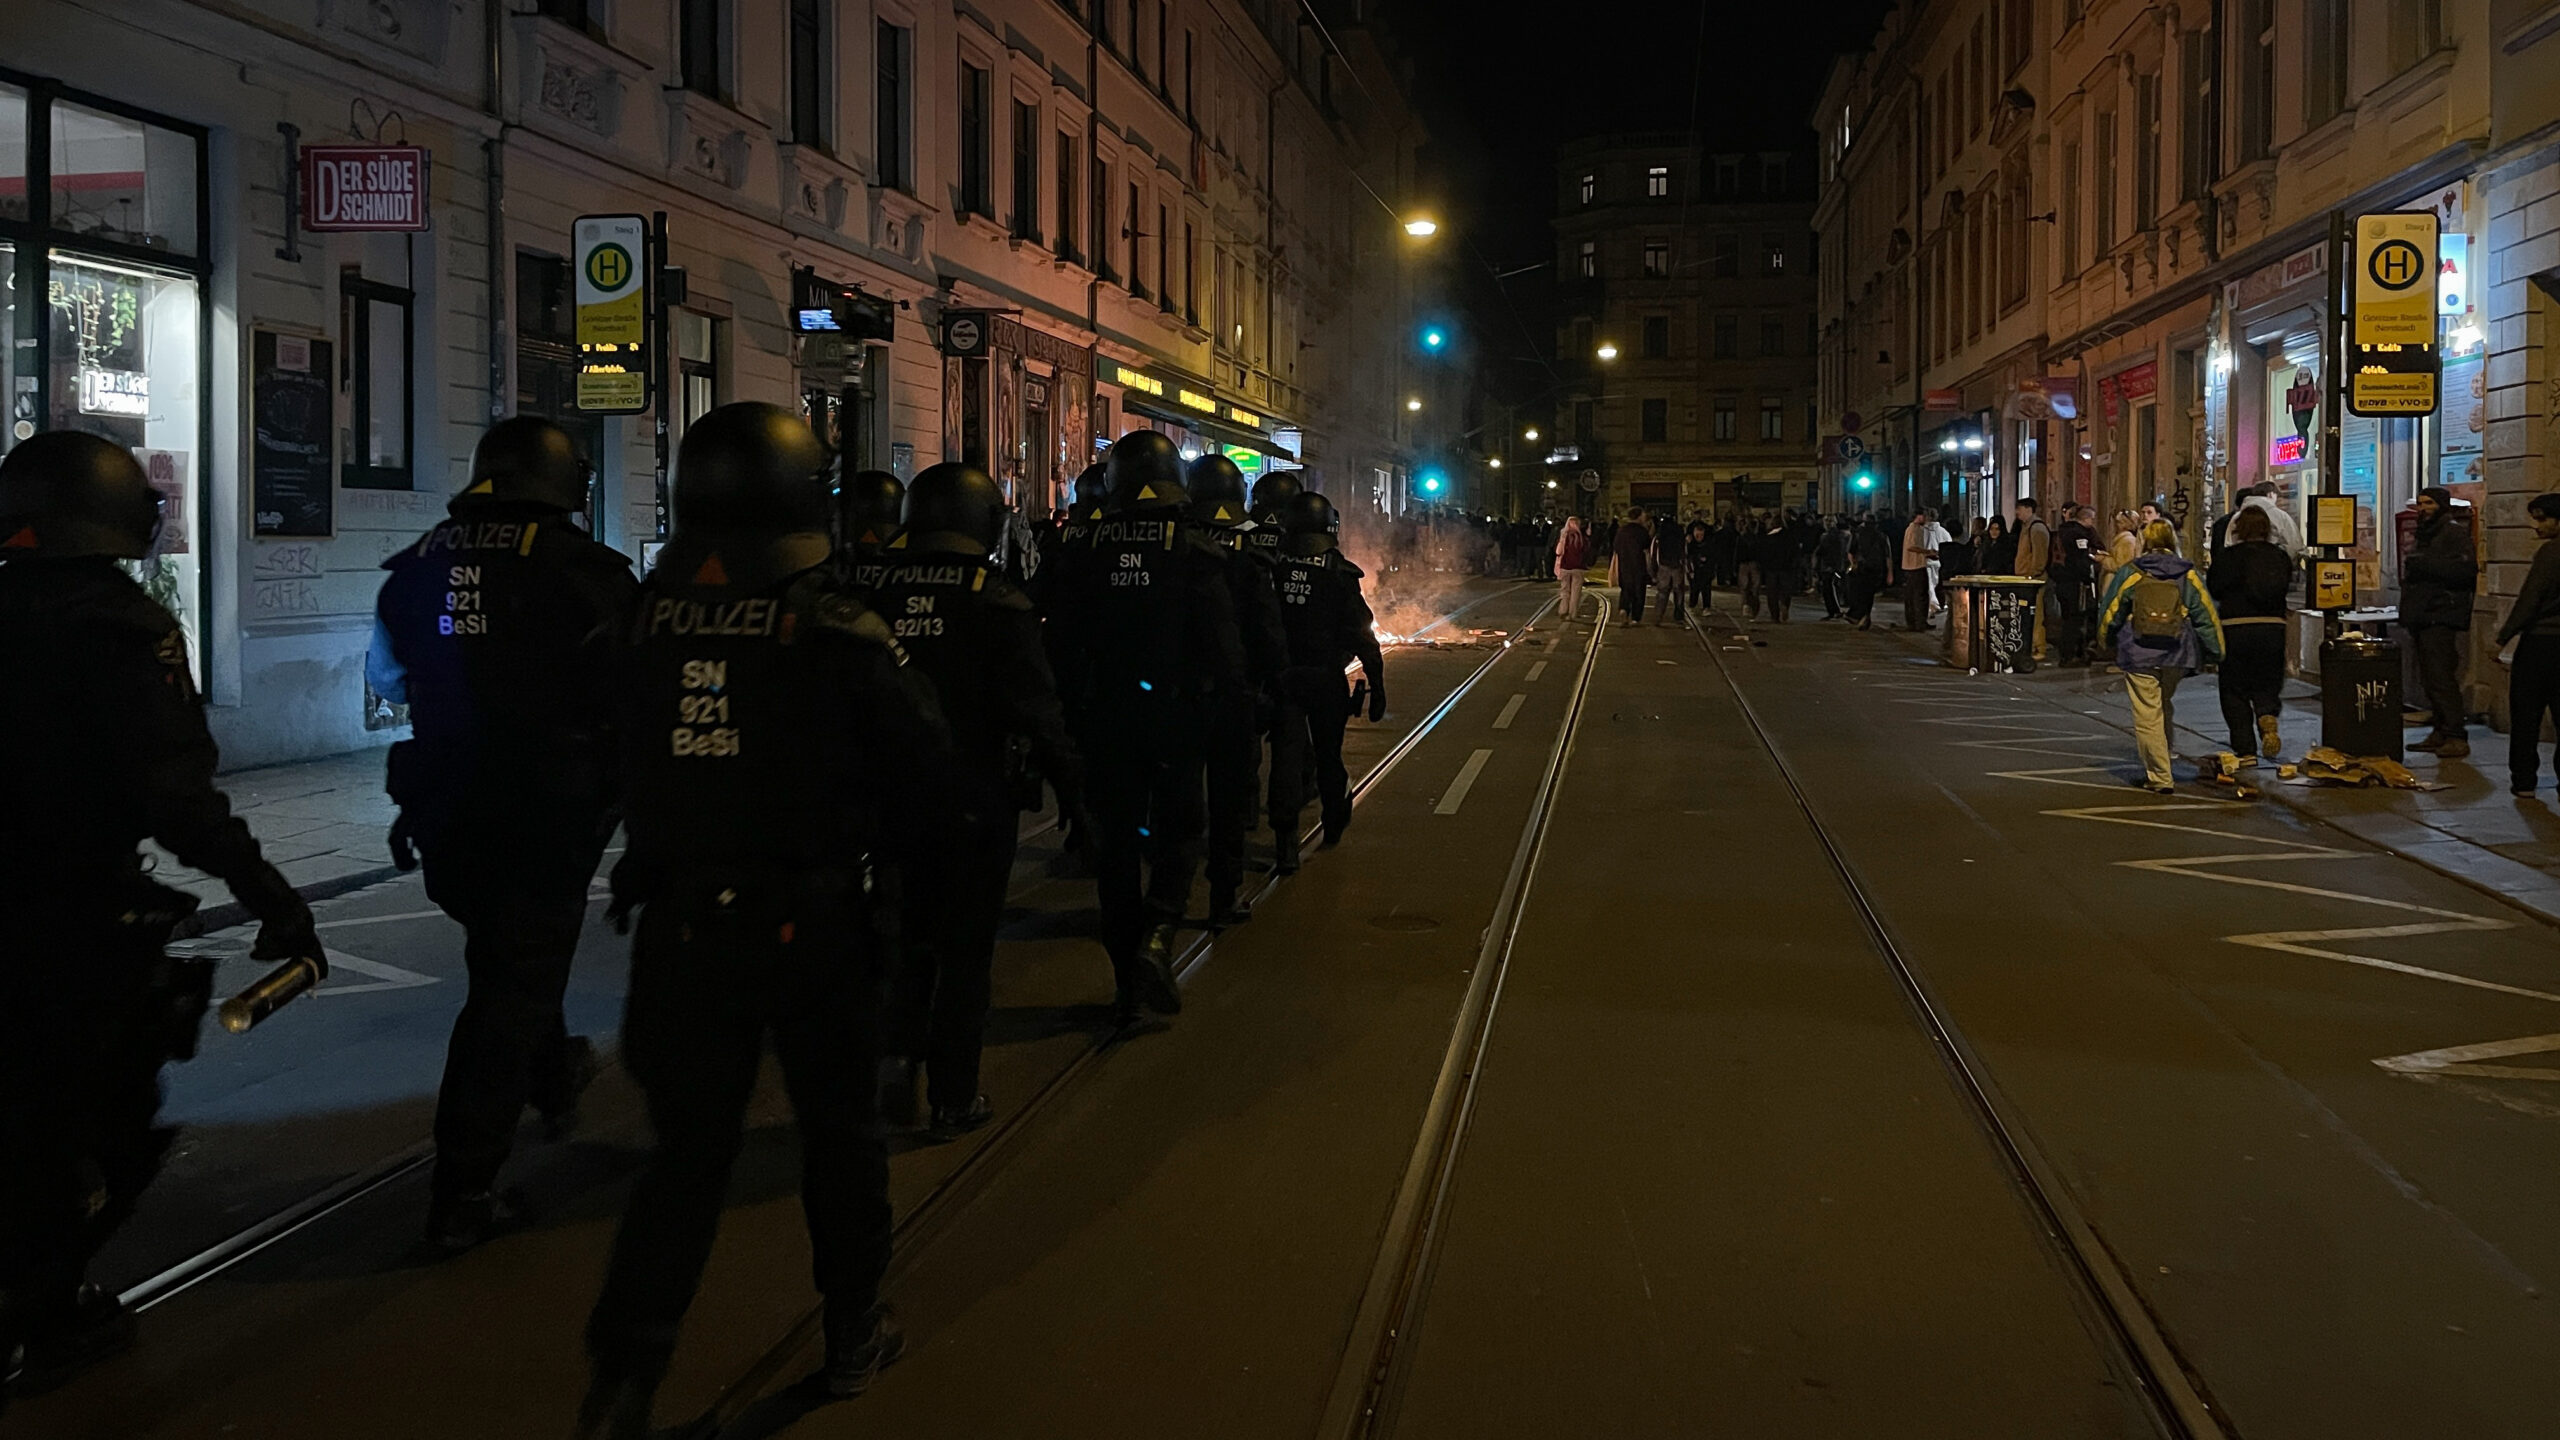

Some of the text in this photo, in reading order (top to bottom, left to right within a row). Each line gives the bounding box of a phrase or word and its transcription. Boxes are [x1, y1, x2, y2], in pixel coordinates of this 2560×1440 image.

[317, 160, 363, 222] DER
[341, 193, 414, 222] SCHMIDT
[600, 253, 618, 282] H
[2385, 250, 2407, 280] H
[2398, 399, 2421, 407] VVO
[431, 522, 522, 552] POLIZEI
[1100, 521, 1163, 541] POLIZEI
[1119, 553, 1142, 568] SN
[448, 566, 481, 587] SN
[1111, 571, 1150, 586] 92/13
[1291, 570, 1308, 582] SN
[2324, 572, 2345, 580] Sitz!
[1283, 582, 1312, 595] 92/12
[445, 591, 480, 611] 921
[905, 595, 935, 615] SN
[438, 614, 488, 635] BeSi
[650, 598, 779, 636] POLIZEI
[894, 617, 944, 637] 92/13
[680, 660, 728, 690] SN
[679, 695, 728, 724] 921
[672, 727, 740, 757] BeSi
